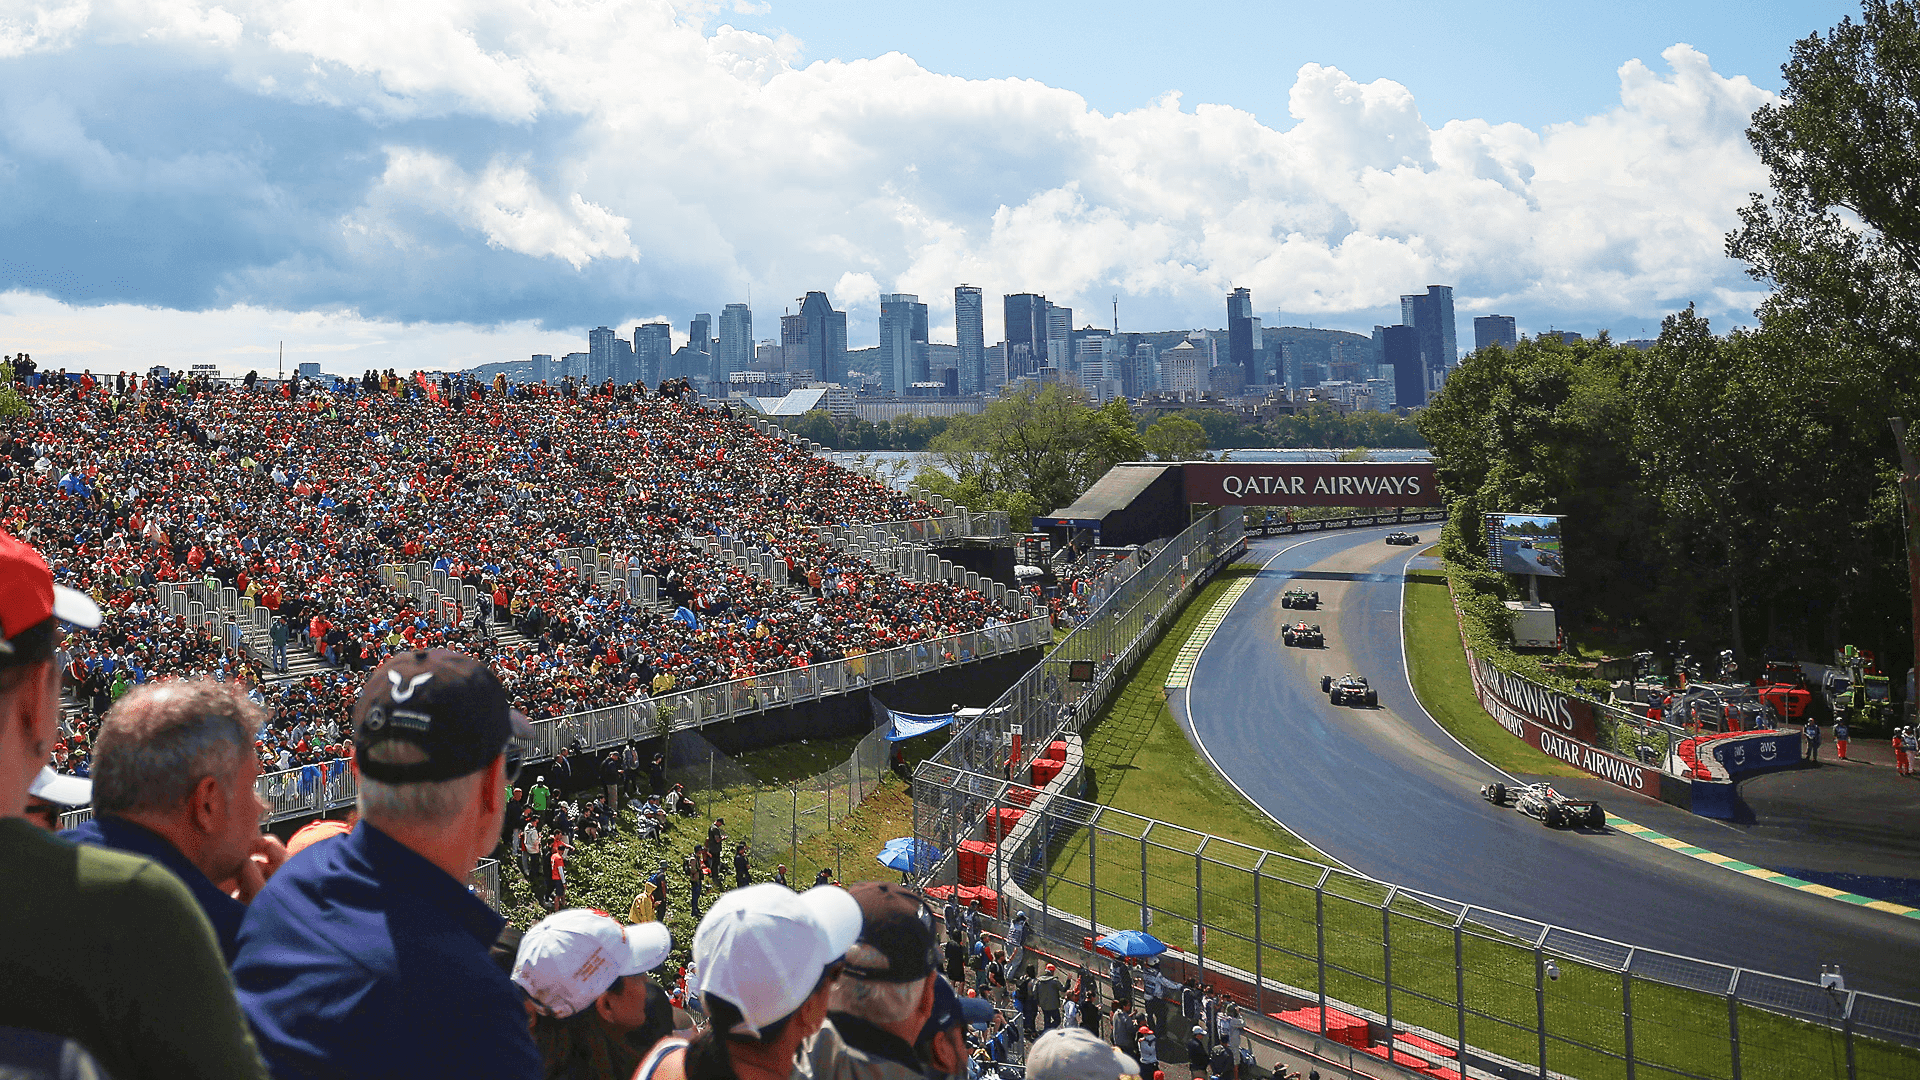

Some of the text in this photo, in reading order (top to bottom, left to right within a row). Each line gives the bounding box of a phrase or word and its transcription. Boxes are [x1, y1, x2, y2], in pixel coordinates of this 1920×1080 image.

[1222, 475, 1421, 498] QATAR AIRWAYS
[1503, 672, 1573, 731] AIRWAYS
[1540, 731, 1643, 789] QATAR AIRWAYS
[1760, 741, 1777, 753] aws
